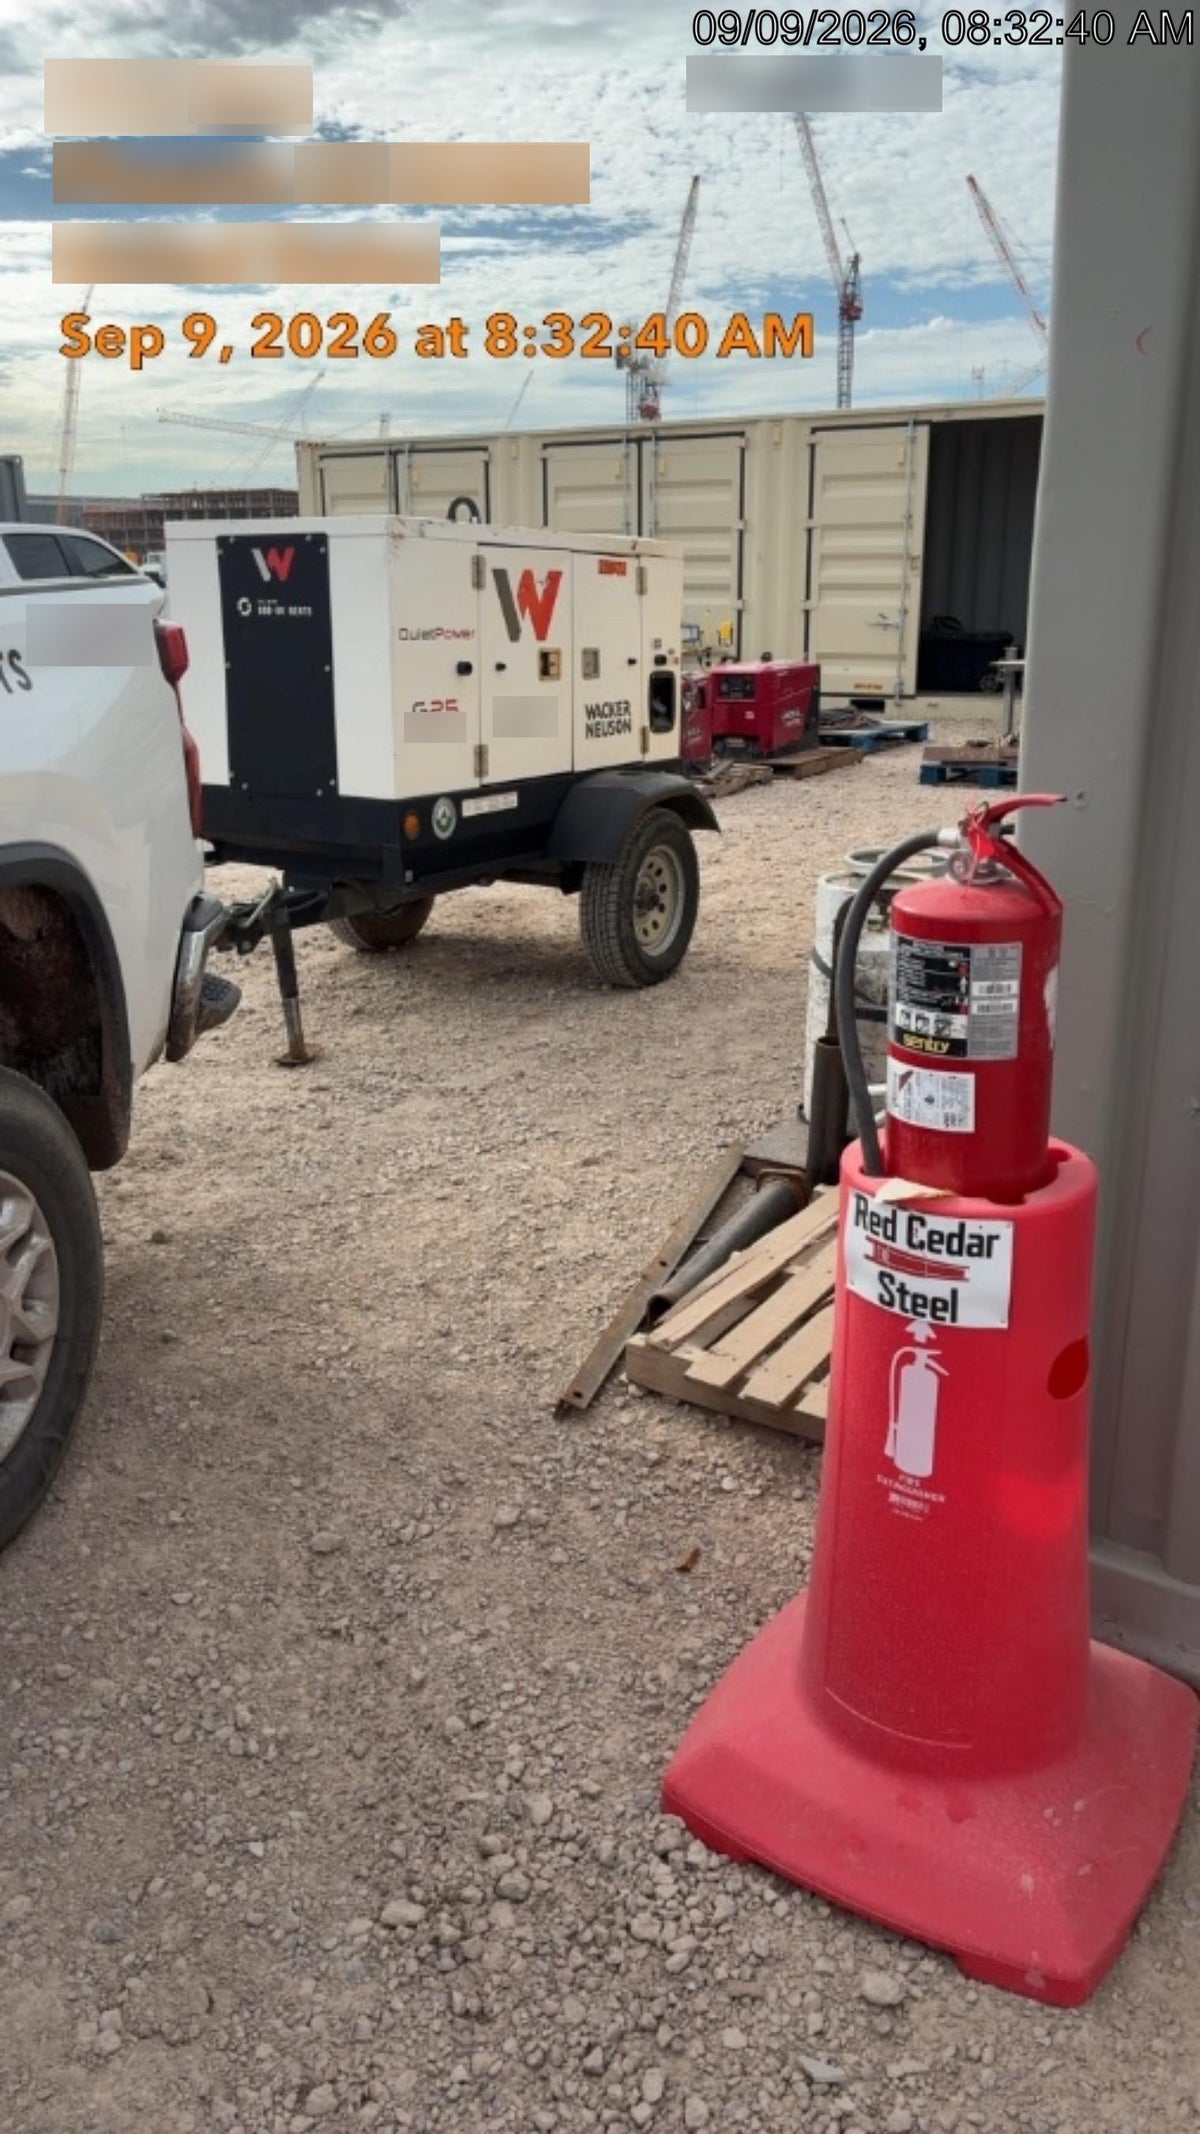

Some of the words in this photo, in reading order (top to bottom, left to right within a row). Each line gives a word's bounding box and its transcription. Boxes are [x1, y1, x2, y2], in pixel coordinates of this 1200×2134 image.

[398, 627, 476, 641] QuietPower
[585, 700, 632, 721] WACKER
[585, 718, 632, 740] NEUSON
[903, 1033, 950, 1054] sentry
[854, 1192, 898, 1244] Red
[907, 1213, 1000, 1259] Cedar
[877, 1270, 959, 1324] Steel
